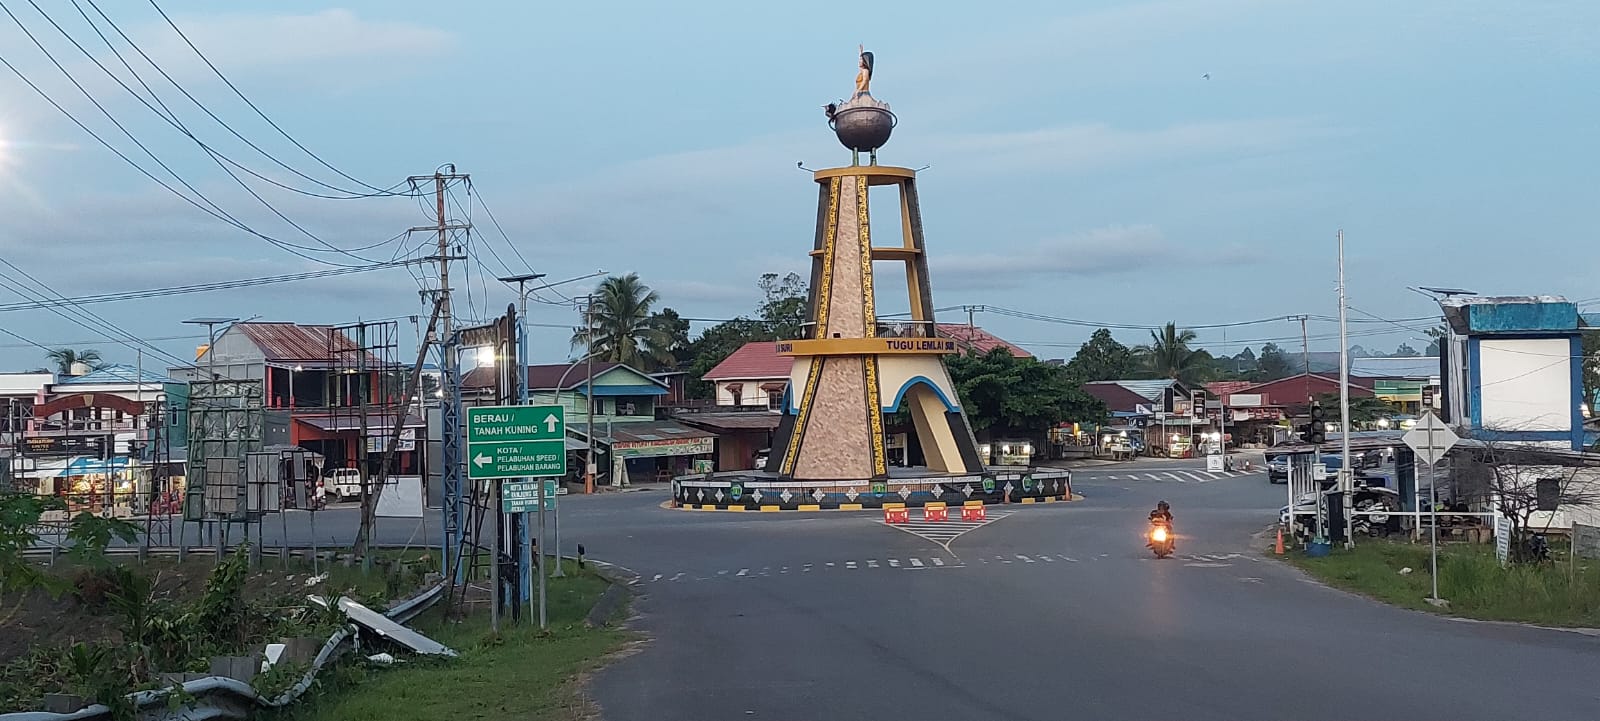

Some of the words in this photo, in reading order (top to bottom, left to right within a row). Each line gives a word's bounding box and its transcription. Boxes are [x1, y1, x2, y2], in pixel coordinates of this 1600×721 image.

[886, 340, 914, 350] TUGU
[916, 340, 944, 350] LEMLAI
[474, 414, 509, 424] BERAU
[511, 413, 514, 422] /
[474, 427, 503, 436] TANAH
[505, 425, 538, 434] KUNING
[497, 455, 535, 463] PELABUHAN
[536, 454, 557, 462] SPEED
[497, 463, 534, 472] PELABUHAN
[535, 462, 561, 471] BARANG
